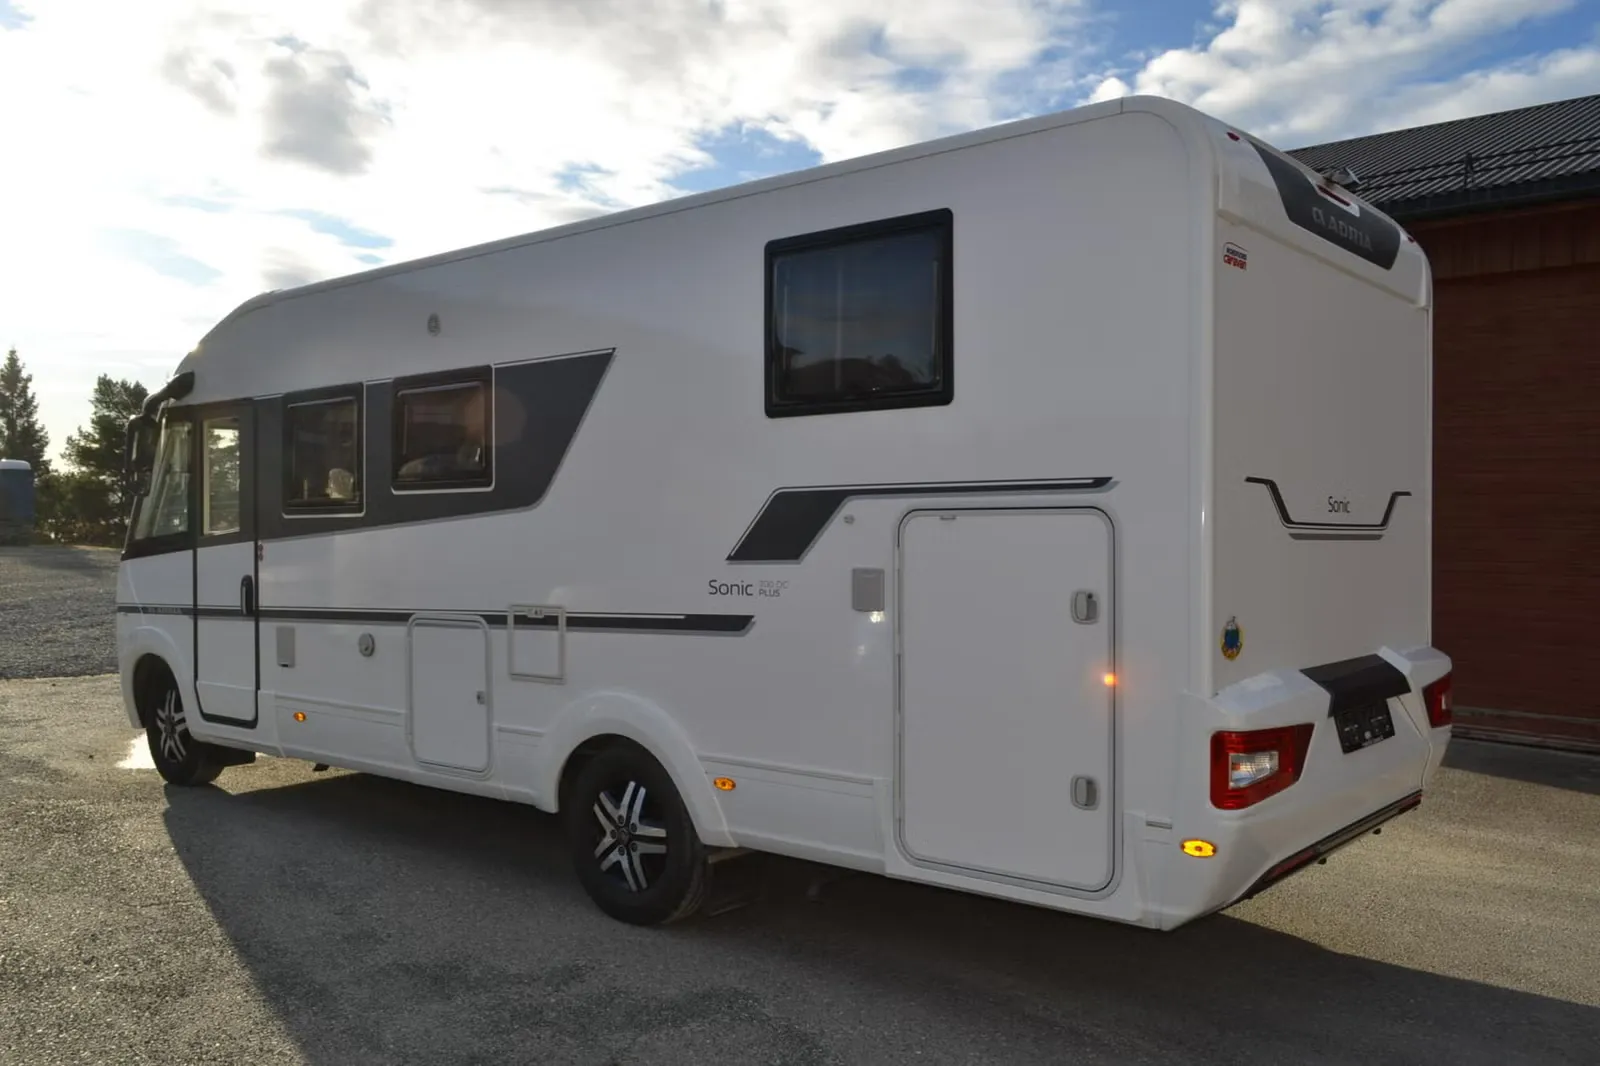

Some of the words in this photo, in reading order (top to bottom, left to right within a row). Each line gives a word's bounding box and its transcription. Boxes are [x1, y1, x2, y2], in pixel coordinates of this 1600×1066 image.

[1328, 495, 1351, 513] Sonic
[708, 579, 754, 596] Sonic
[758, 588, 781, 597] PLUS
